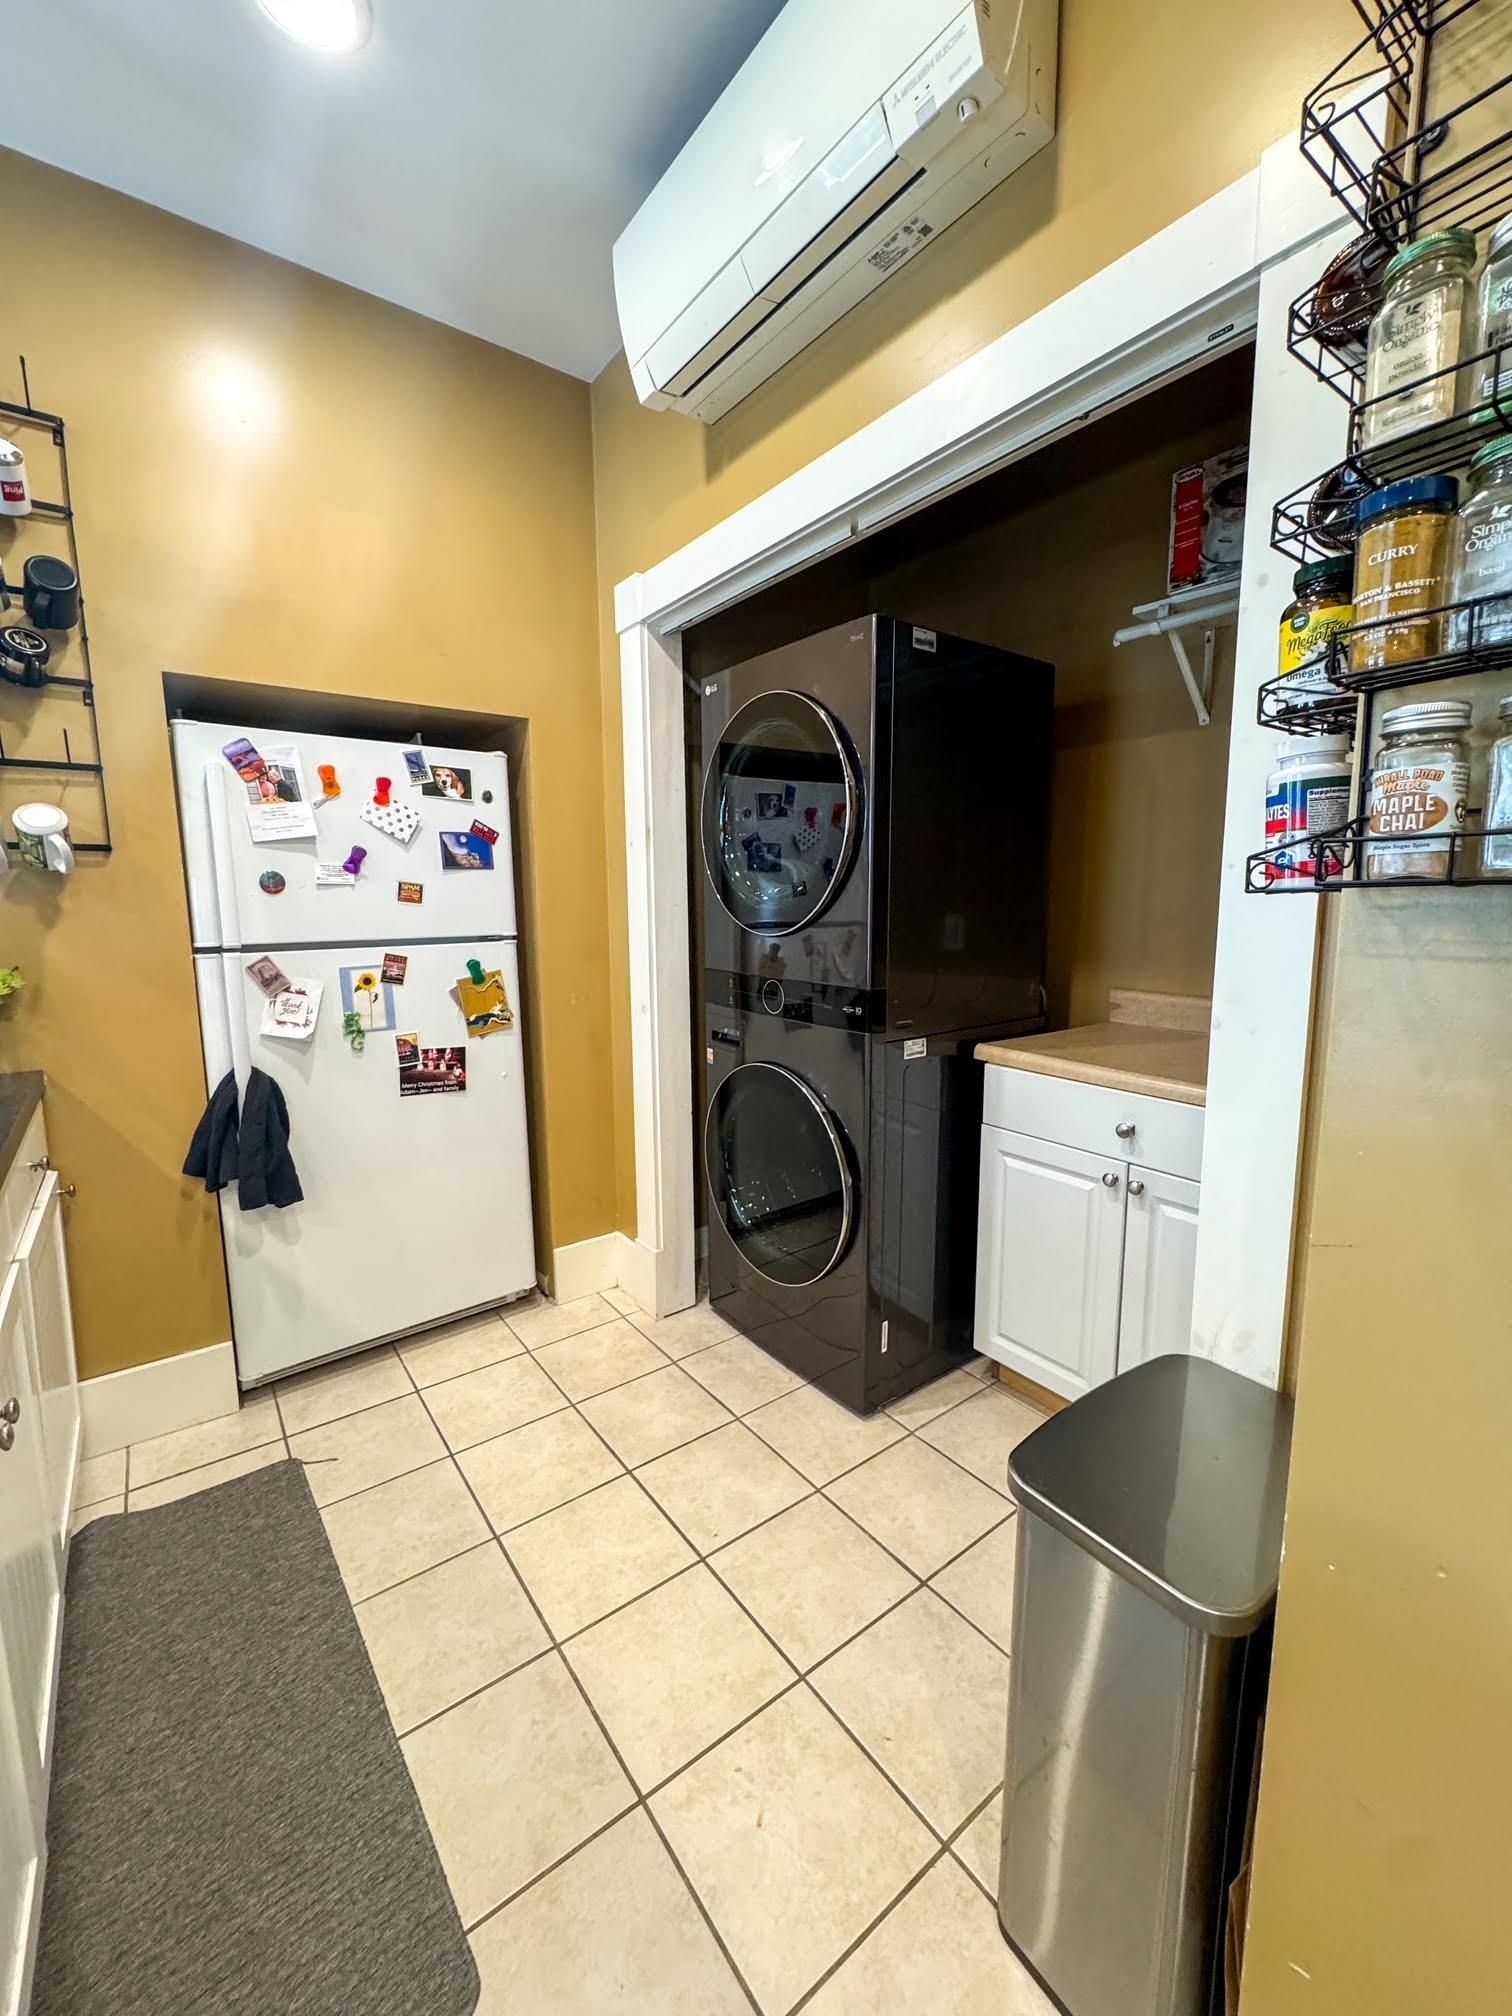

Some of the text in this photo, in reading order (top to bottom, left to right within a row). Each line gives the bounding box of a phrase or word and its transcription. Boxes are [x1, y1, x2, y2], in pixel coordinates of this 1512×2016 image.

[1382, 322, 1438, 352] Organic
[1471, 519, 1512, 539] Simp
[1465, 530, 1512, 552] Organ
[1368, 544, 1418, 566] CURRY
[1479, 562, 1505, 577] basil
[1374, 588, 1420, 603] FRANCISCO
[711, 684, 718, 692] LG
[1412, 768, 1444, 781] ROAD
[1309, 788, 1351, 796] Supplemen
[1373, 794, 1436, 816] MAPLE
[1380, 813, 1425, 832] CHAI
[400, 884, 420, 892] SPAM
[444, 1085, 459, 1093] family
